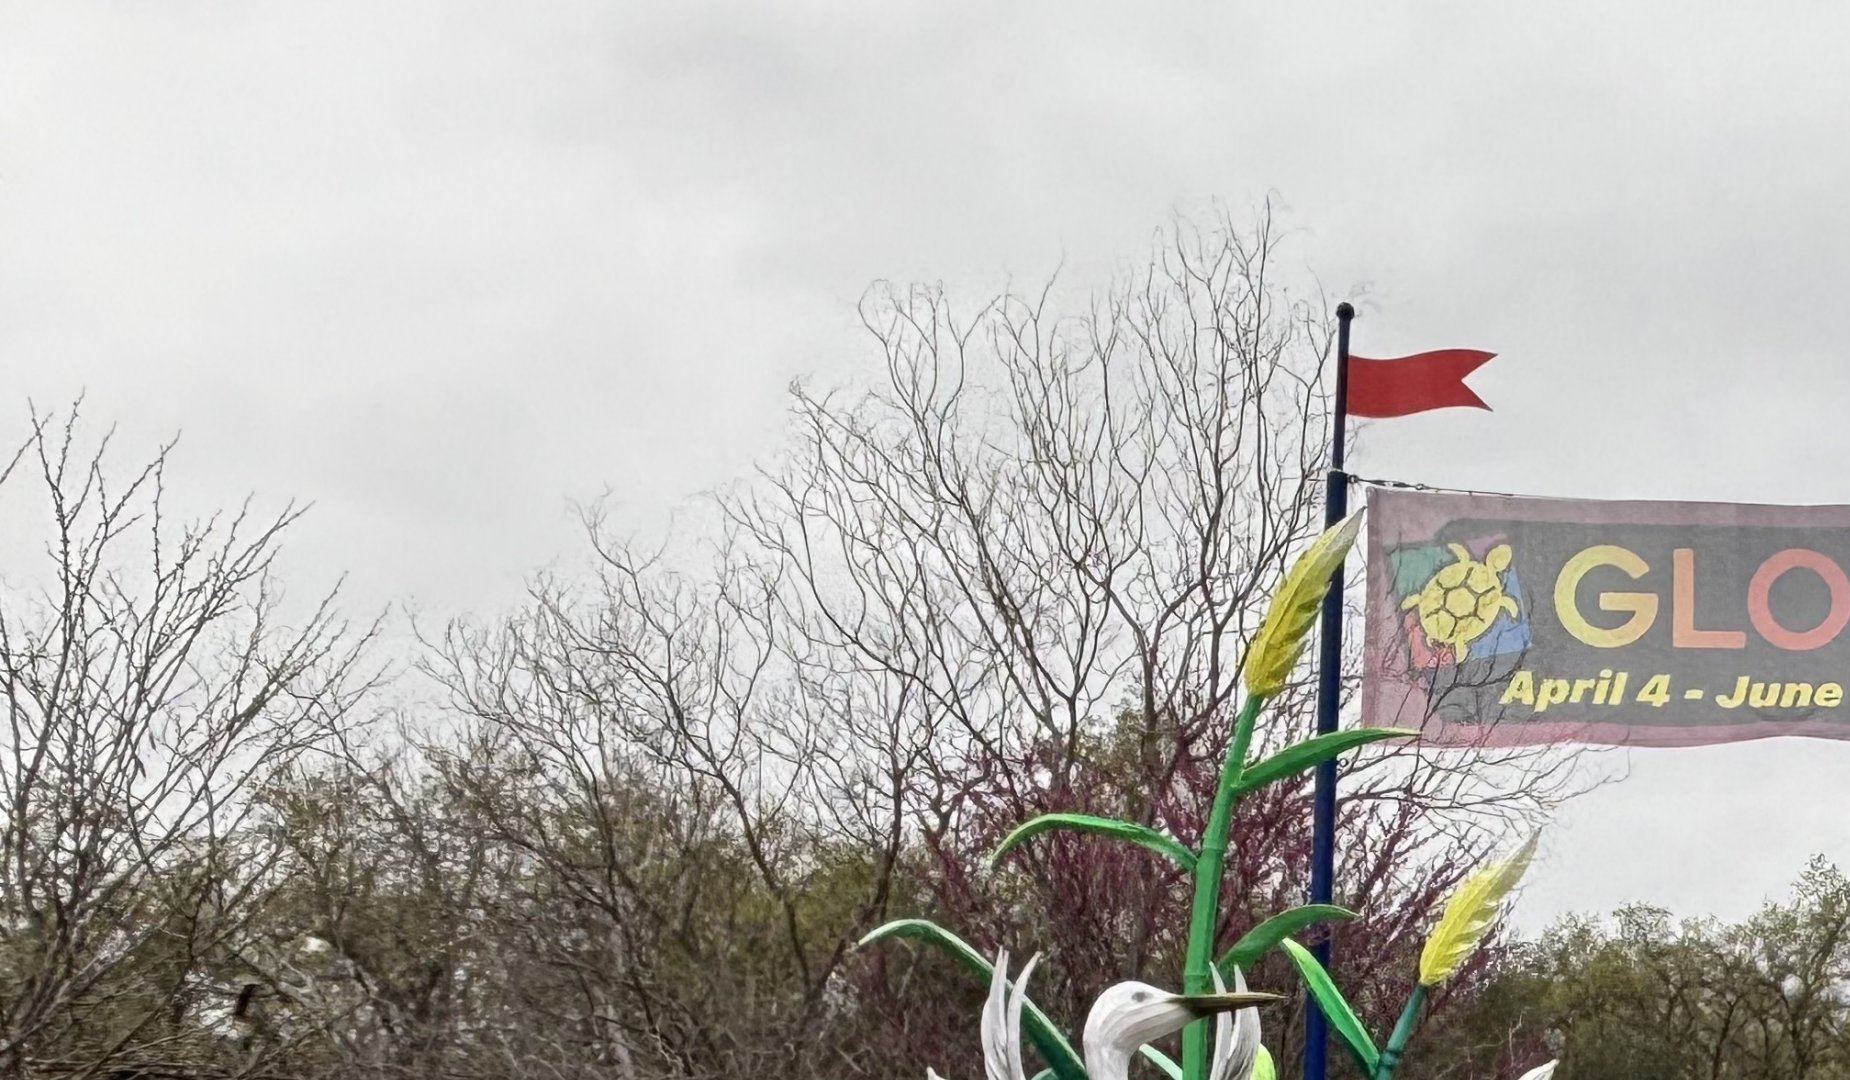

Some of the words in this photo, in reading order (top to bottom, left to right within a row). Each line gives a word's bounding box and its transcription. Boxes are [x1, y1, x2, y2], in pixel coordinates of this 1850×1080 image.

[1502, 669, 1628, 713] April
[1636, 674, 1671, 707] 4
[1715, 675, 1843, 708] June
